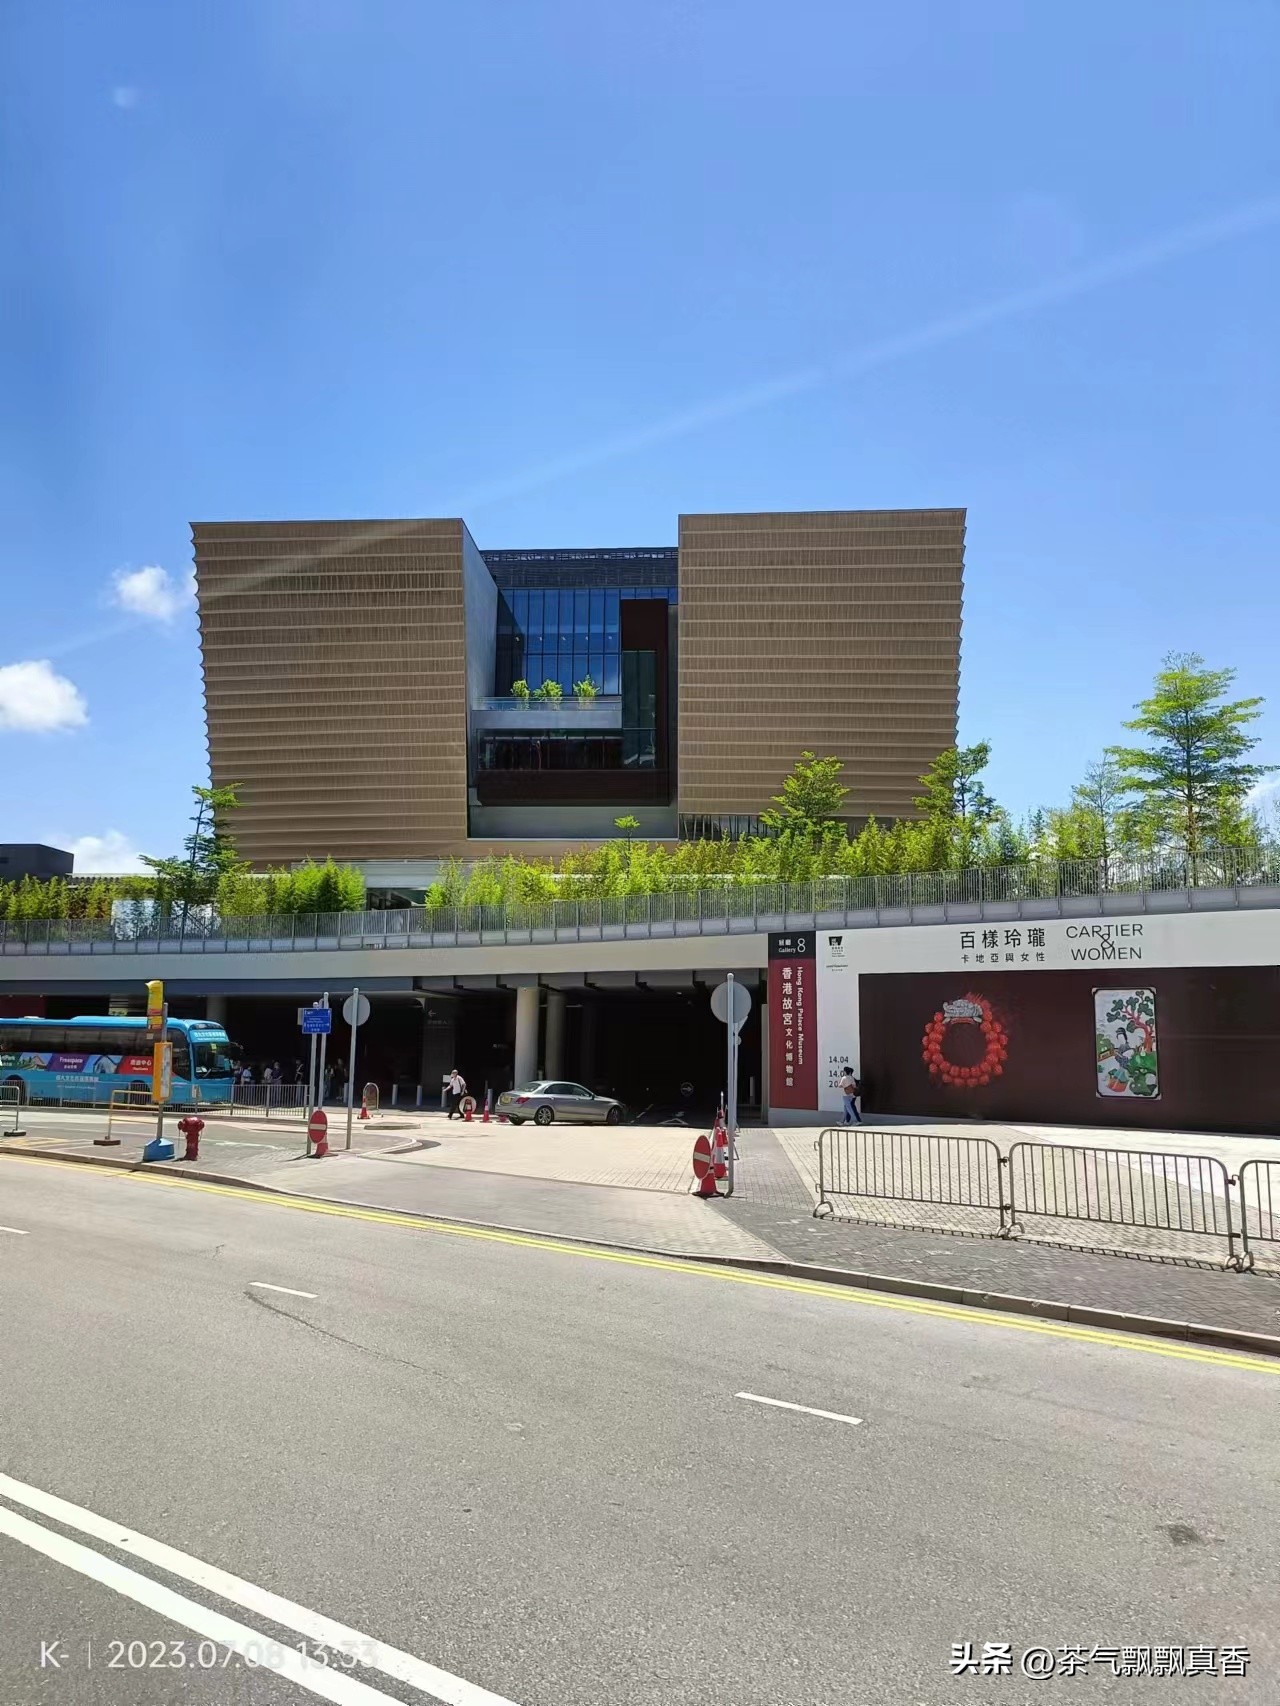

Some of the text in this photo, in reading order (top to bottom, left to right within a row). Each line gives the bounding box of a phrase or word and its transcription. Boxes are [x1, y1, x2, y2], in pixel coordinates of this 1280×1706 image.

[959, 927, 1046, 950] 百樣玲瓏
[1066, 923, 1143, 939] CARTIER
[797, 937, 806, 953] 8
[960, 951, 1046, 964] 卡地亞與女性
[1071, 947, 1142, 961] WOMEN
[795, 966, 804, 986] Hong
[795, 987, 804, 1007] Kong
[797, 1033, 805, 1065] Museum
[829, 1055, 849, 1064] 14.04
[829, 1070, 845, 1078] 14.0
